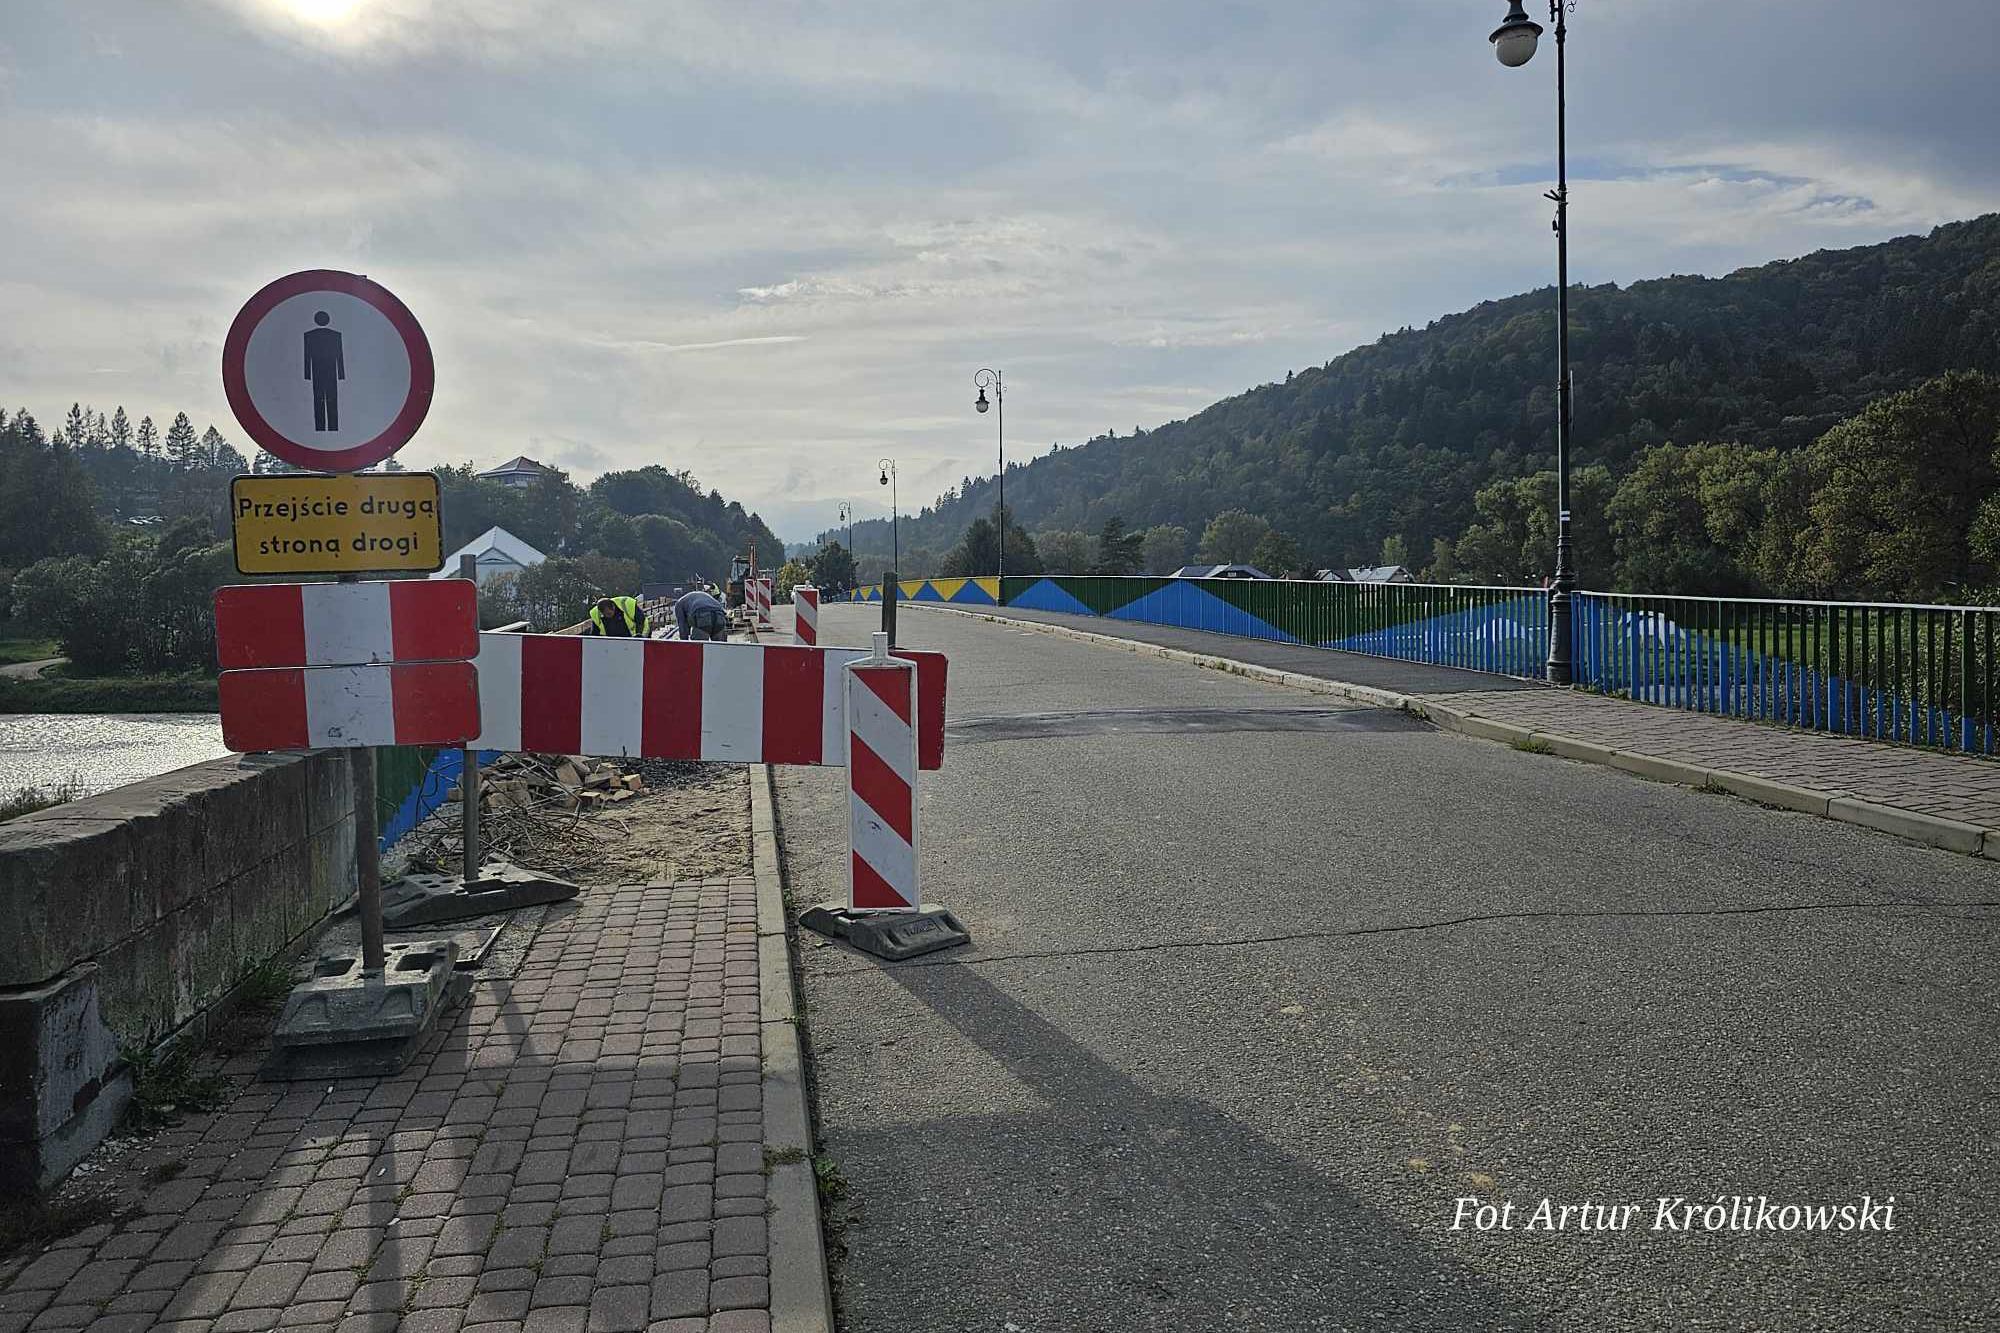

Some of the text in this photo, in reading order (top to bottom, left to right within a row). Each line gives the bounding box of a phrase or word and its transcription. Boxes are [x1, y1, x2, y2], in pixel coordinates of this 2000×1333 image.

[239, 495, 434, 521] Przejście drugą
[259, 531, 418, 558] stroną drogi
